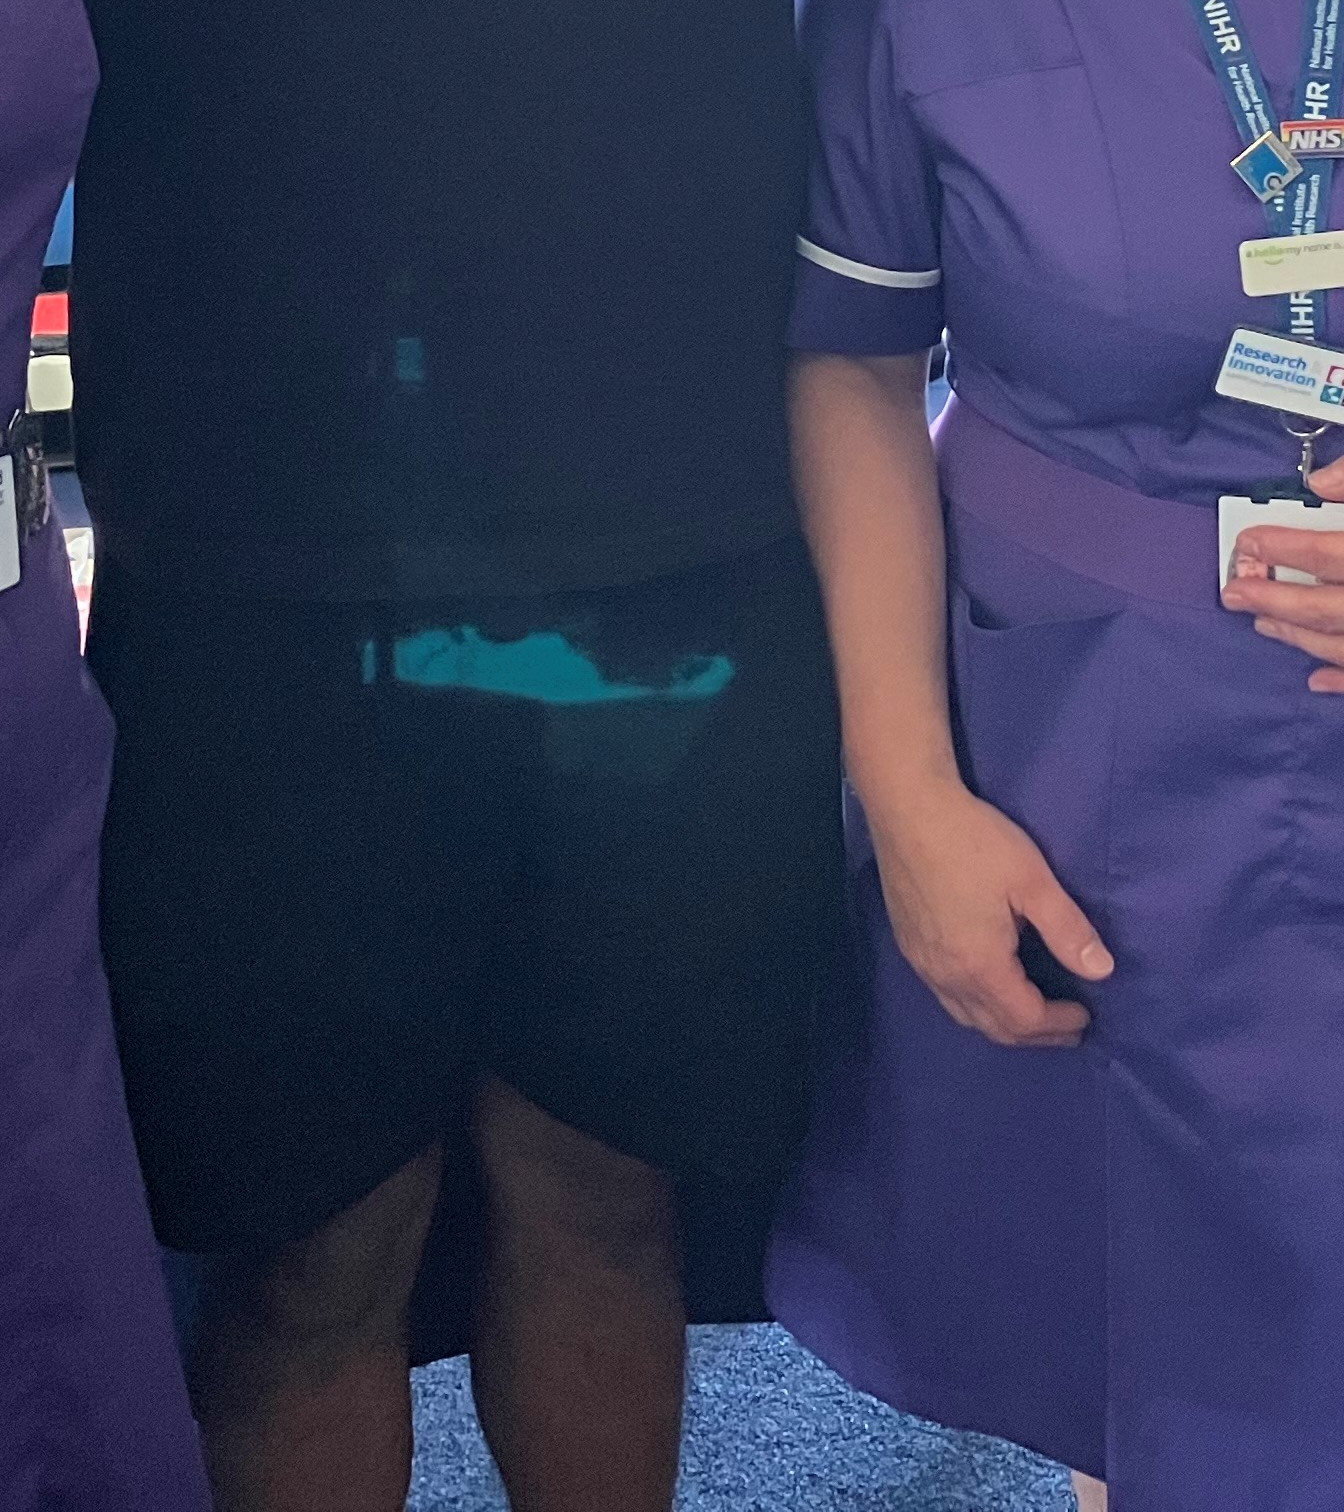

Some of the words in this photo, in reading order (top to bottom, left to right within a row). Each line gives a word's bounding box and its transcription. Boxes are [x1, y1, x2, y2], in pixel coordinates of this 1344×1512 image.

[1303, 81, 1331, 120] HR
[1291, 130, 1342, 150] NHS
[1290, 290, 1315, 340] IHR
[1228, 356, 1317, 388] Innovation
[1233, 342, 1307, 371] Research
